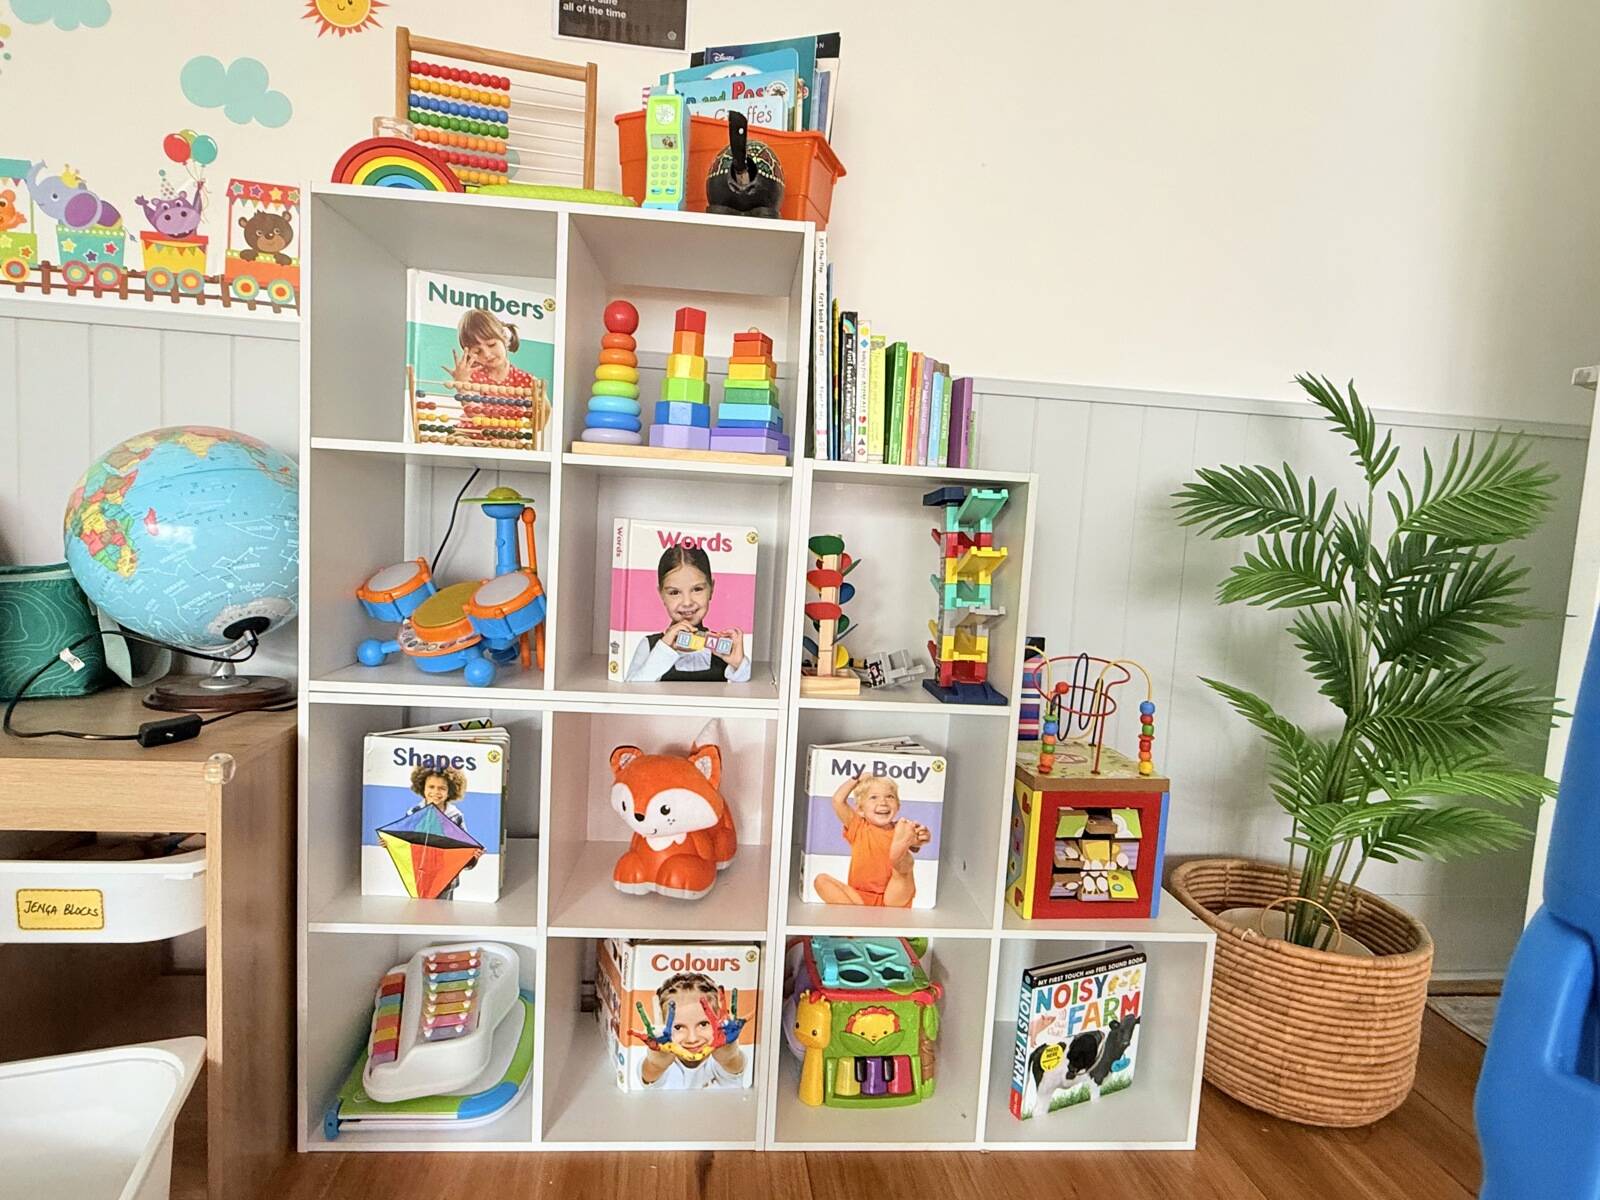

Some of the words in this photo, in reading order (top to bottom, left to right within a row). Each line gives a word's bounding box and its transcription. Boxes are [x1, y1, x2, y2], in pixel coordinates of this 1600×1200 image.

[563, 2, 574, 12] all
[576, 4, 586, 14] of
[588, 5, 604, 16] the
[605, 8, 627, 19] time
[428, 281, 544, 320] Numbers
[616, 526, 624, 558] Words
[657, 530, 733, 553] Words
[393, 747, 477, 774] Shapes
[831, 758, 866, 780] My
[872, 761, 931, 784] Body
[23, 900, 57, 916] JENGA
[651, 953, 741, 972] Colours
[1048, 976, 1064, 984] FIRST
[1064, 971, 1084, 980] TOUCH
[1108, 961, 1128, 970] SOUND
[1128, 957, 1144, 966] BOOK
[1035, 975, 1109, 1014] NOISY
[1016, 984, 1033, 1041] NOISY
[1066, 991, 1141, 1037] FARM
[1013, 1041, 1027, 1087] FARM
